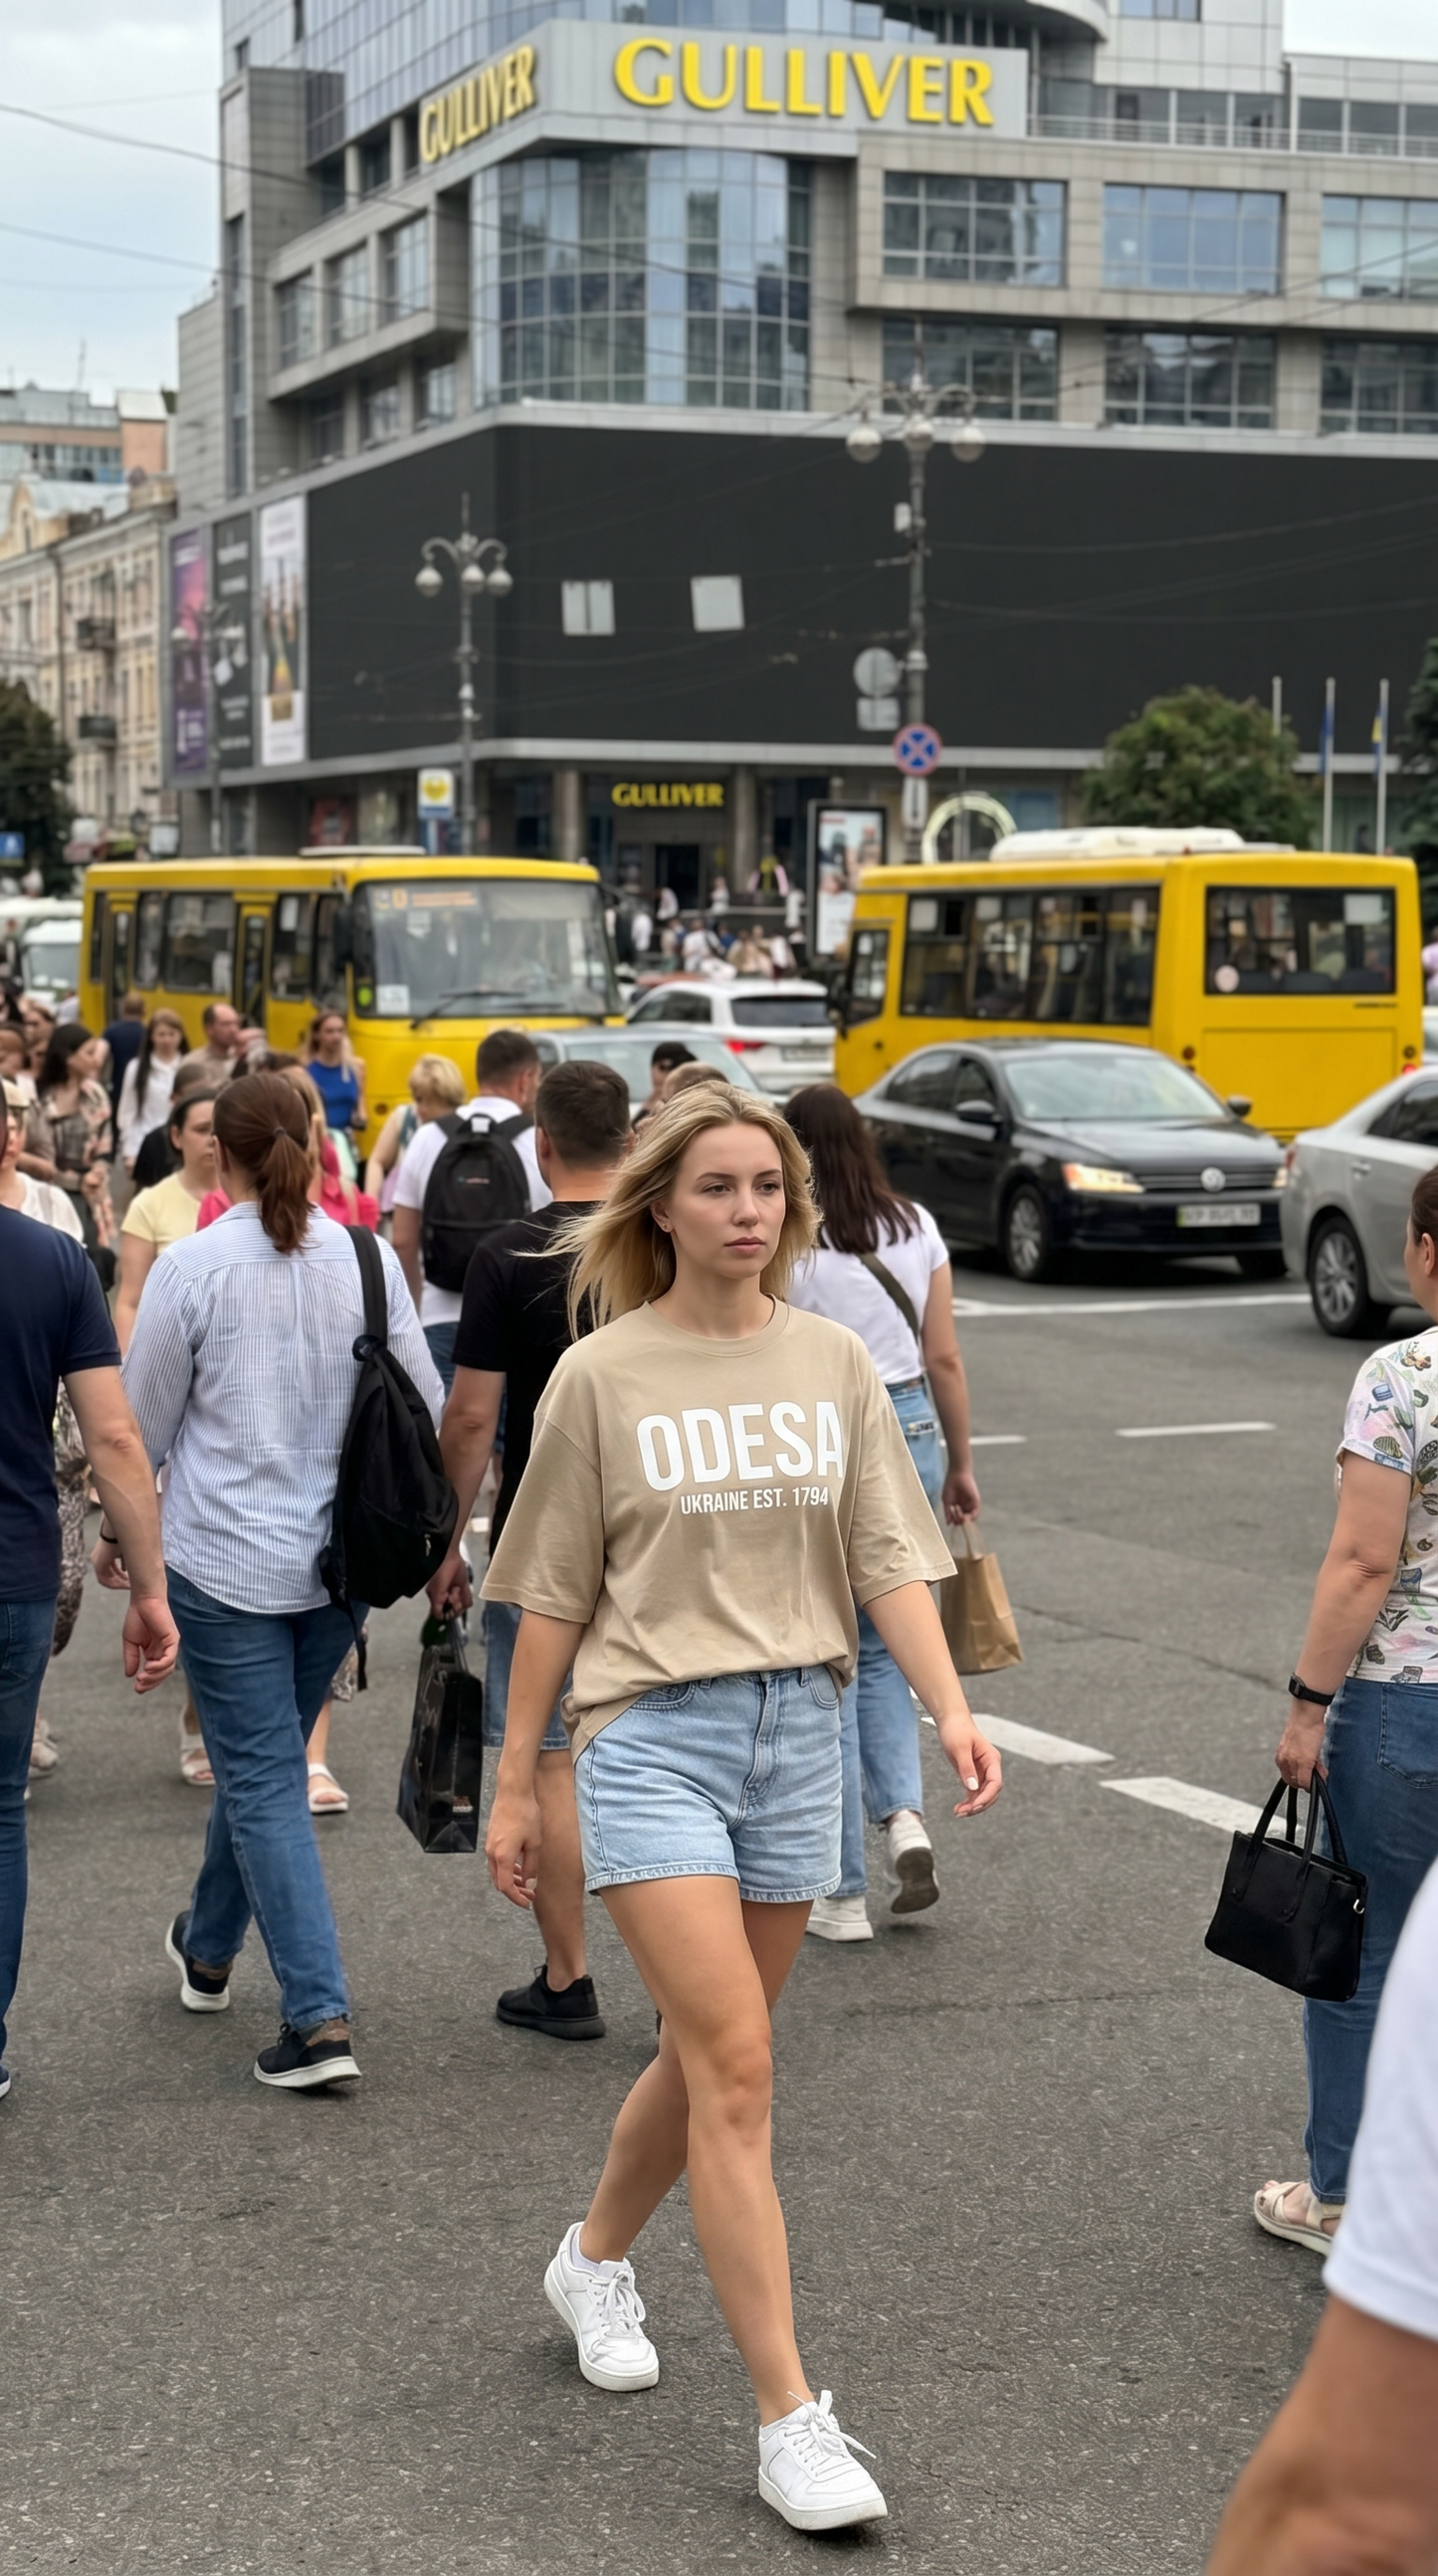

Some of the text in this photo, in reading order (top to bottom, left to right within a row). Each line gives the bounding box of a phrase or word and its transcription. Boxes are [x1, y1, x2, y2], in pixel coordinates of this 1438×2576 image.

[419, 45, 533, 162] GULLIVER
[614, 38, 993, 124] GULLIVER
[611, 782, 724, 808] GULLIVER
[637, 1401, 844, 1491] ODESA
[681, 1486, 829, 1514] UKRAINE EST. 1794
